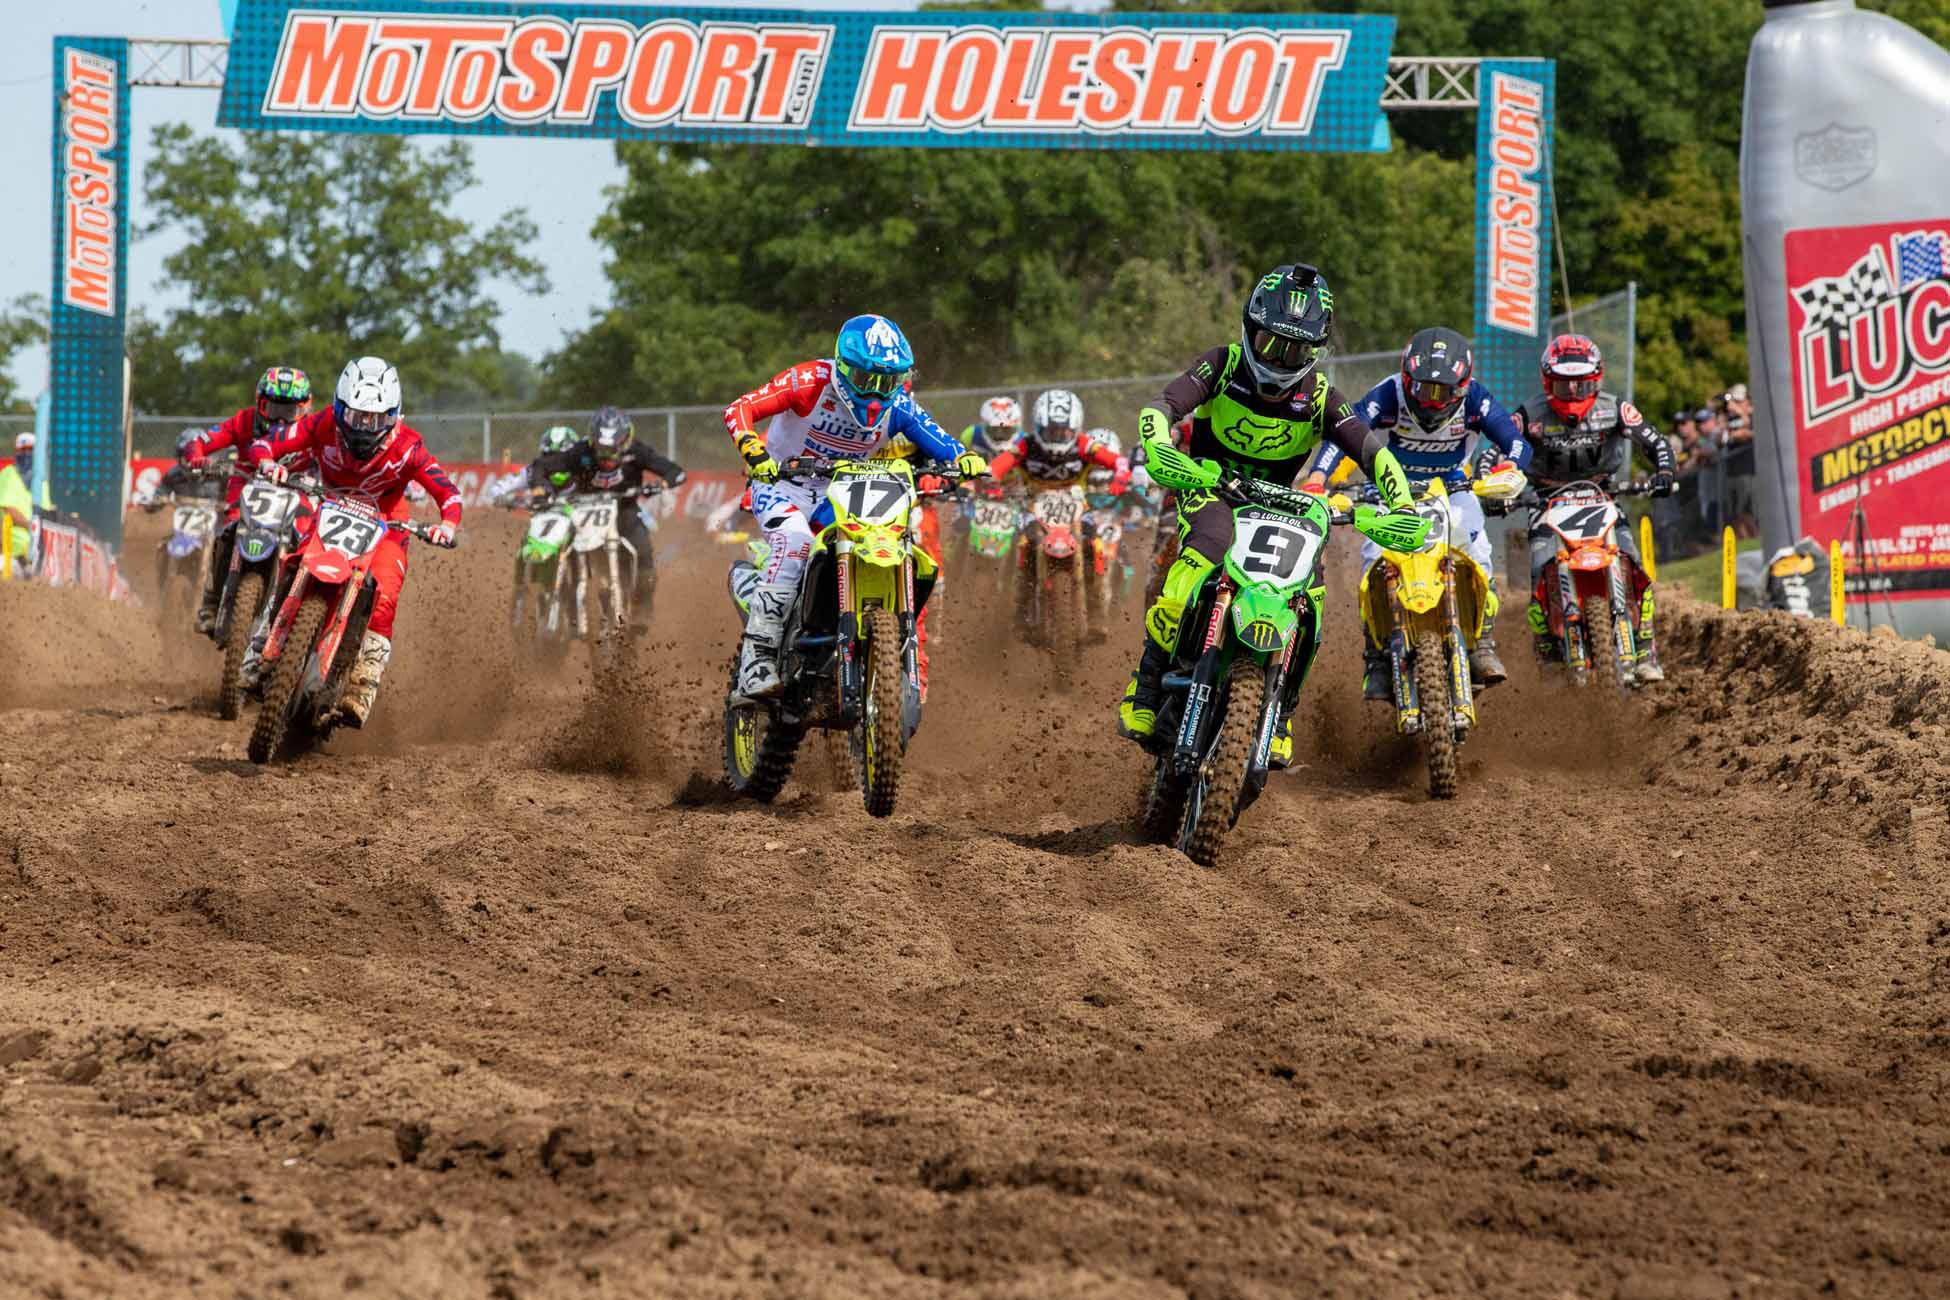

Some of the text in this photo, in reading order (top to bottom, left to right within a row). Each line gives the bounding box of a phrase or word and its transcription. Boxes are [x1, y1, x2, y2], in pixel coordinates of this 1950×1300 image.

[855, 28, 1340, 132] HOLESHOT
[1850, 400, 1893, 437] HIGH
[1398, 438, 1461, 453] THOR
[1153, 467, 1204, 486] ACERBIS
[1402, 464, 1452, 473] UZUKI
[846, 480, 907, 519] 17
[320, 514, 376, 555] 23
[1261, 512, 1303, 528] LUCAS OIL
[1364, 527, 1416, 545] ACERBIS
[1557, 505, 1610, 538] 4
[1242, 524, 1307, 580] 9
